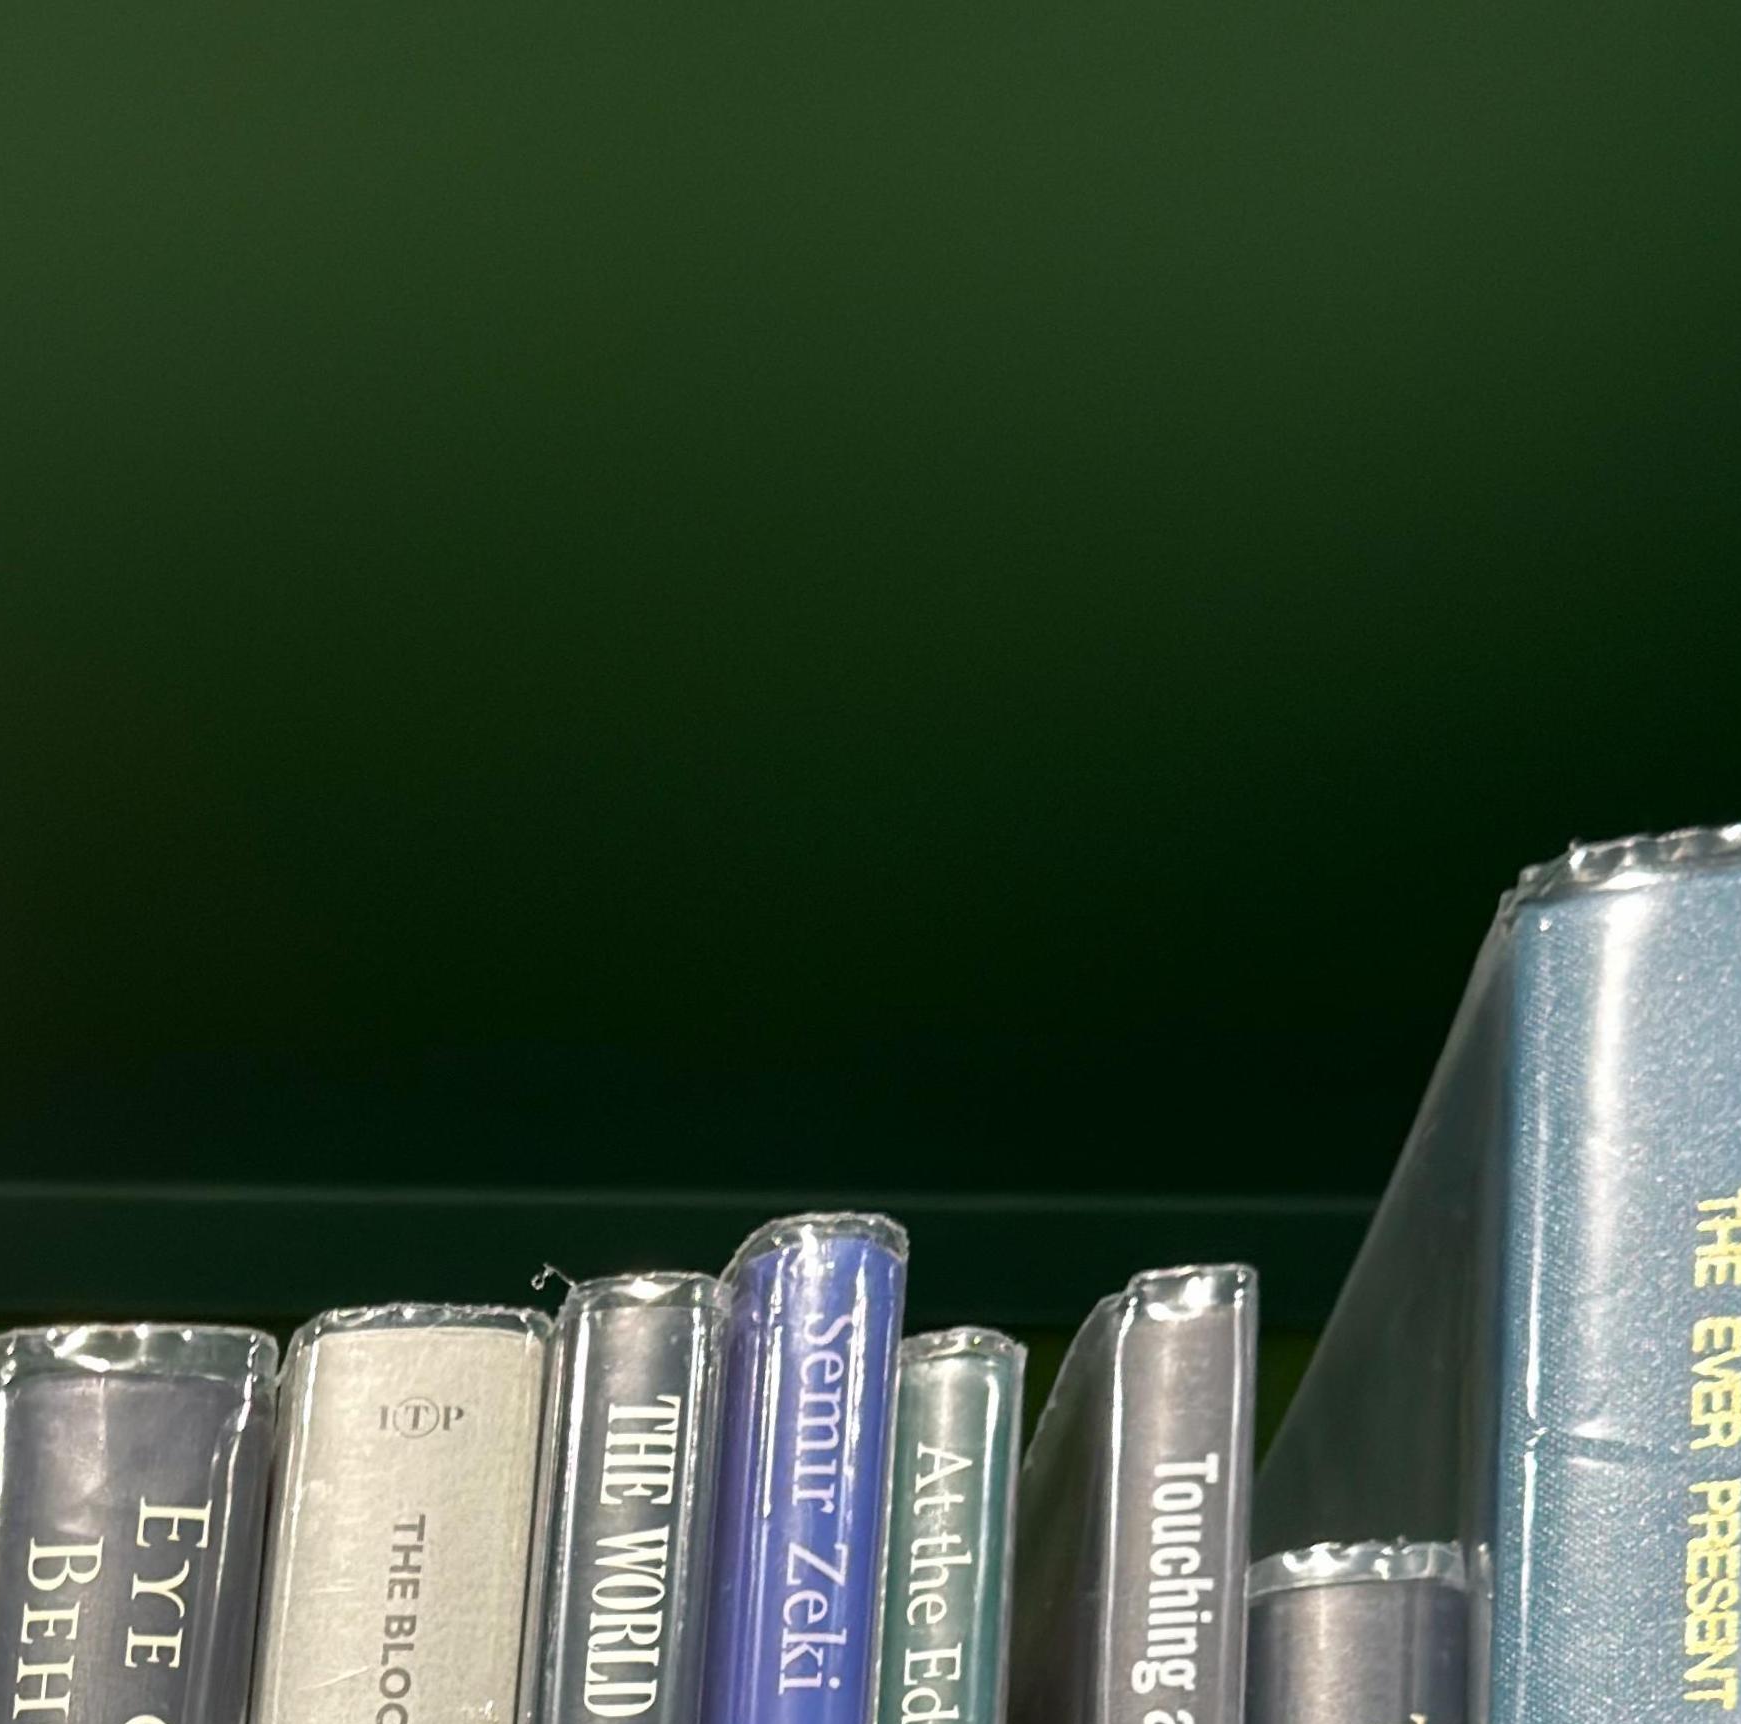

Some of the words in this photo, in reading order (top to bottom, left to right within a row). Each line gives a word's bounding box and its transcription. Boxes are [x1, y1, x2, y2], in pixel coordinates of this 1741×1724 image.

[793, 1309, 856, 1514] Semir
[126, 1498, 214, 1669] EYE
[778, 1544, 848, 1698] Zeki
[1131, 1451, 1219, 1695] Touching
